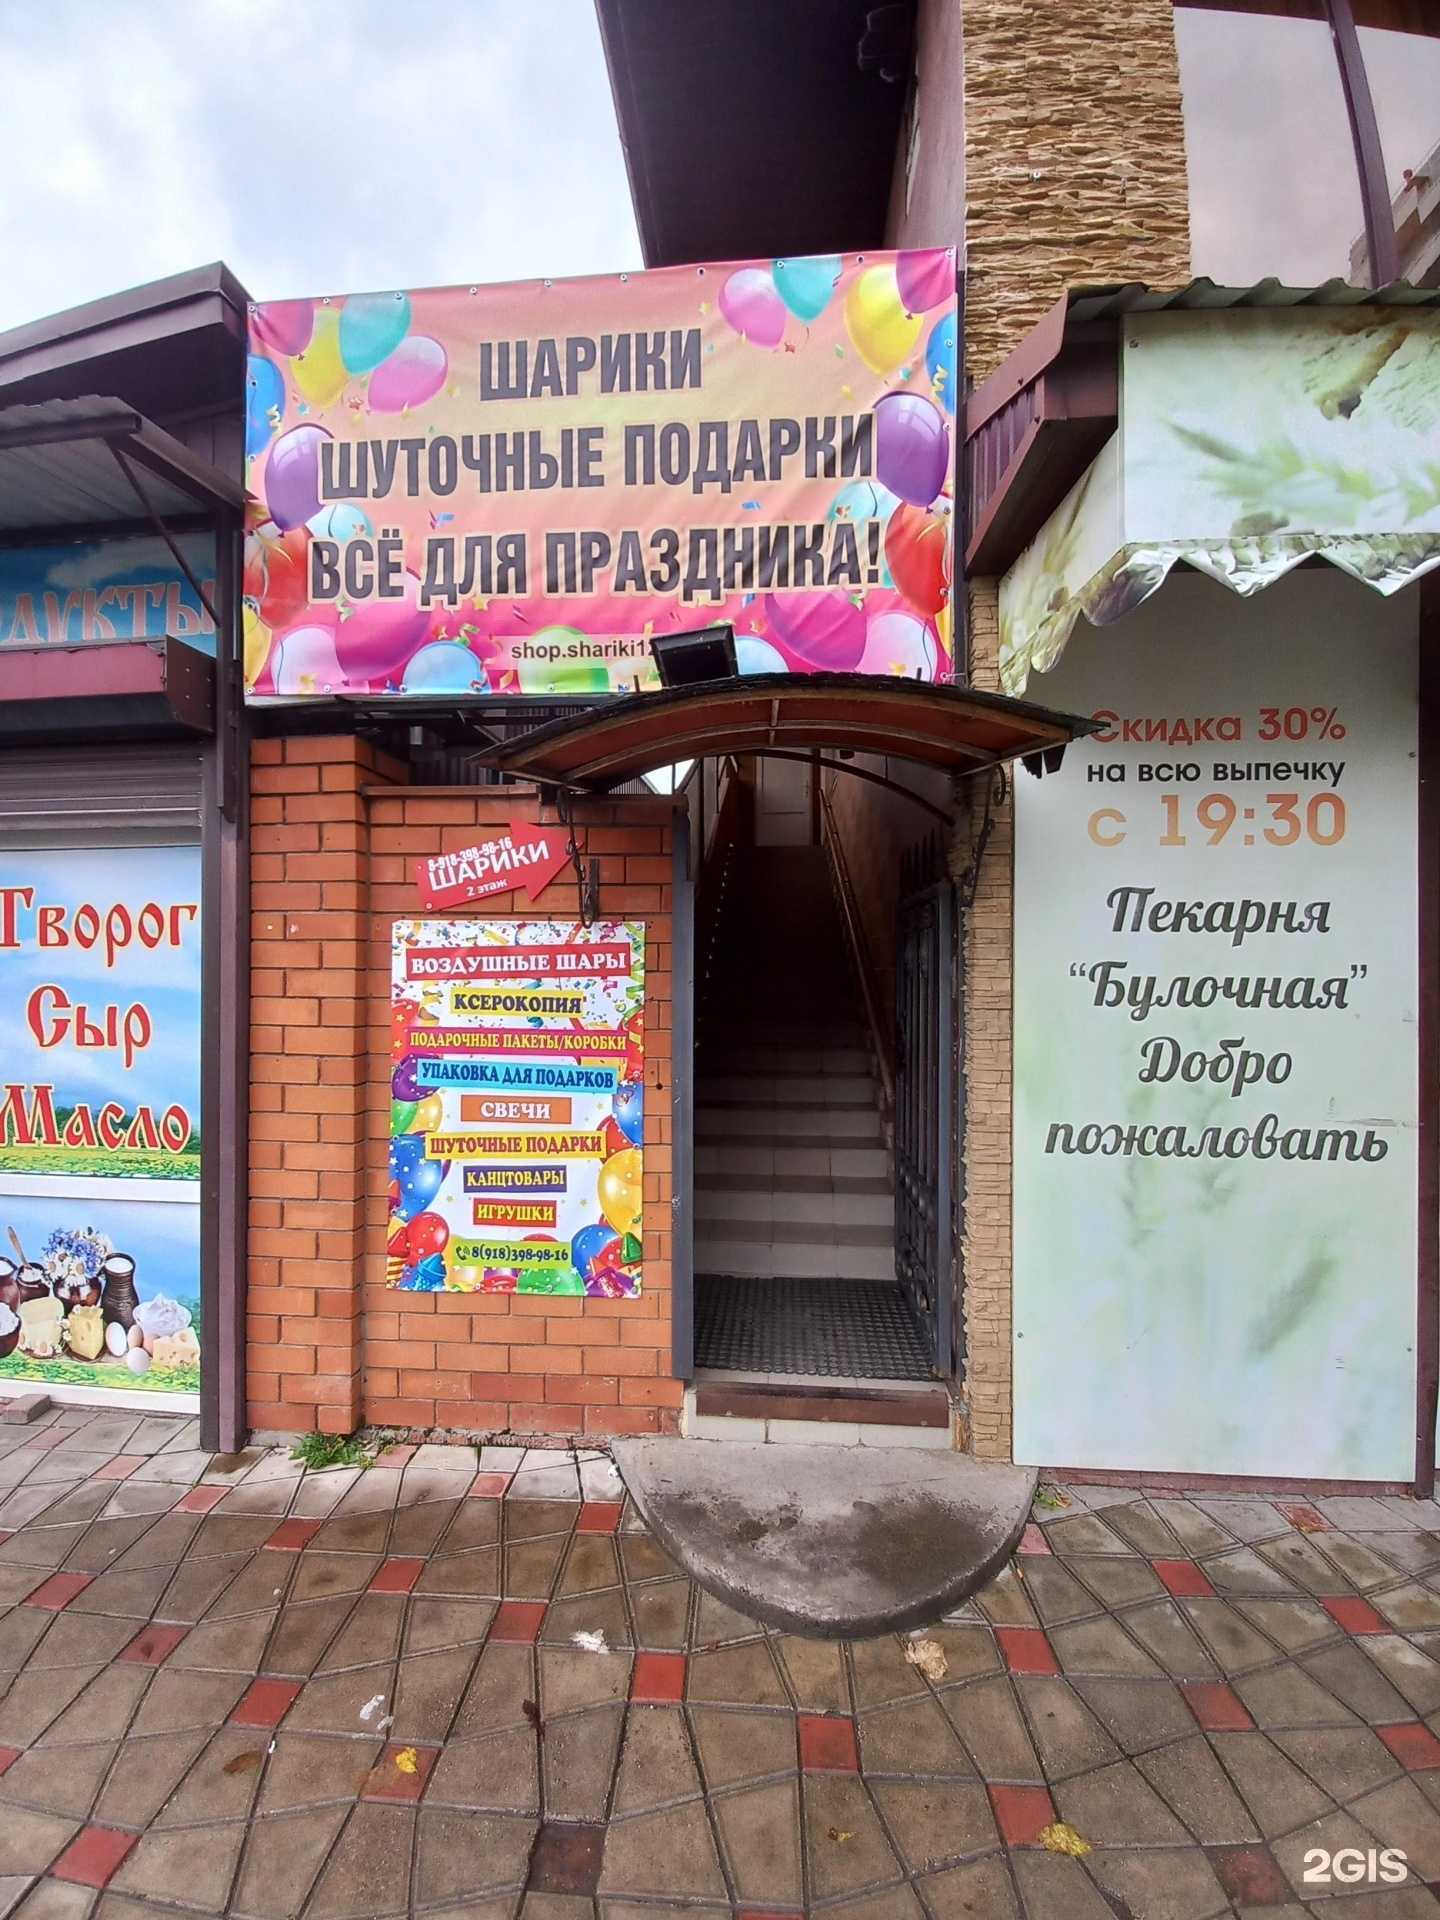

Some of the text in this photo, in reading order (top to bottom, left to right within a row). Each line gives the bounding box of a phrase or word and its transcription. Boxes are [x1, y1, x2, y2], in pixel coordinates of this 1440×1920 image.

[480, 328, 701, 401] ШАРИКИ
[321, 413, 876, 501] ШУТОЧНЫЕ ПОДАРКИ
[312, 521, 881, 606] ВСЁ ДЛЯ ПРАЗДНИКА!
[1090, 708, 1346, 746] Скидка 30%
[1087, 760, 1346, 787] на всю выпечку
[1087, 793, 1346, 848] с 19:30
[427, 836, 513, 872] 8-918-398-98-16
[429, 840, 550, 891] ШАРИКИ
[466, 879, 508, 896] 2 этаж
[0, 887, 198, 968] Творог
[1106, 886, 1330, 947] Пекарня
[411, 952, 626, 975] ВОЗДУШНЫЕ ШАРЫ
[454, 993, 582, 1014] КСЕРОКОПИЯ
[27, 985, 152, 1069] Сыр
[410, 1032, 626, 1051] ПОДАРОЧНЫЕ ПАКЕТЫ/КОРОБКИ
[421, 1062, 614, 1089] УПАКОВКА ДЛЯ ПОДАРКОВ
[1138, 1036, 1293, 1097] Добро
[0, 1085, 190, 1152] Масло
[480, 1101, 551, 1120] СВЕЧИ
[430, 1135, 602, 1154] ШУТОЧНЫЕ ПОДАРКИ
[1044, 1112, 1388, 1162] пожаловать
[467, 1169, 565, 1188] КАНЦТОВАРЫ
[477, 1204, 553, 1221] ИГРУШКИ
[471, 1243, 569, 1261] 8(918)398-98-16
